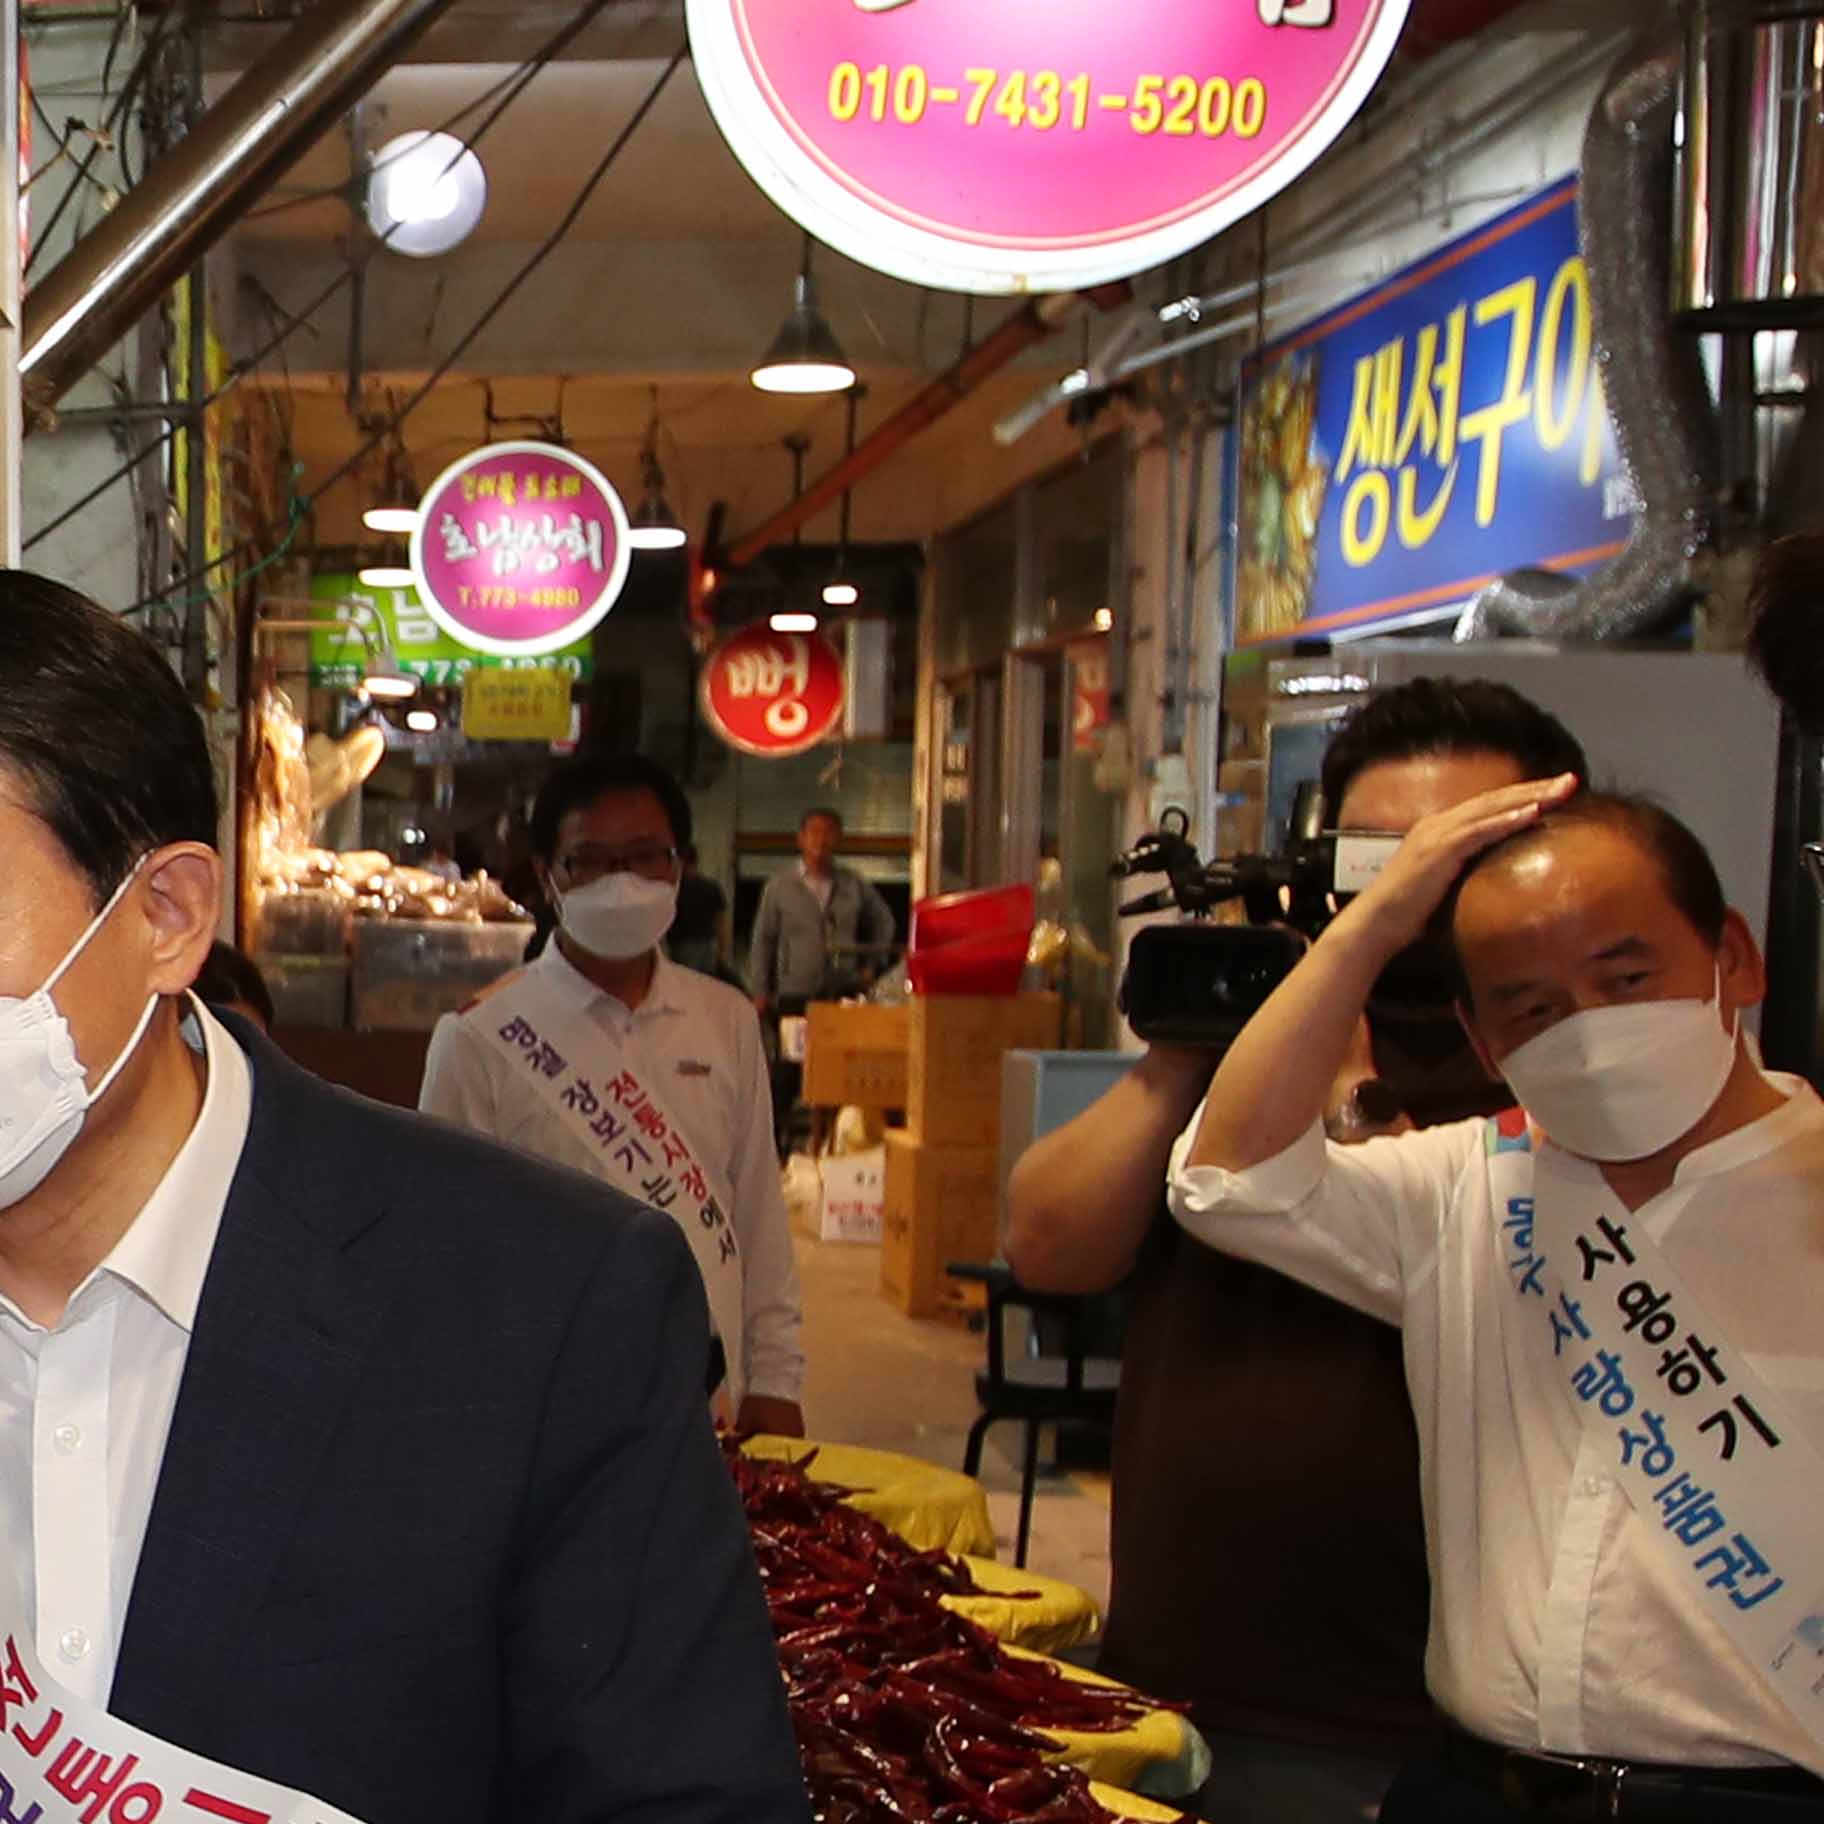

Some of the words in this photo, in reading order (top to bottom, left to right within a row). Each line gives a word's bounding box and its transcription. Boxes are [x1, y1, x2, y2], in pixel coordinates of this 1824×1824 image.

[828, 61, 1266, 137] 010-7431-5200
[1335, 256, 1600, 567] 생선구이
[1574, 1214, 1781, 1461] 사용하기
